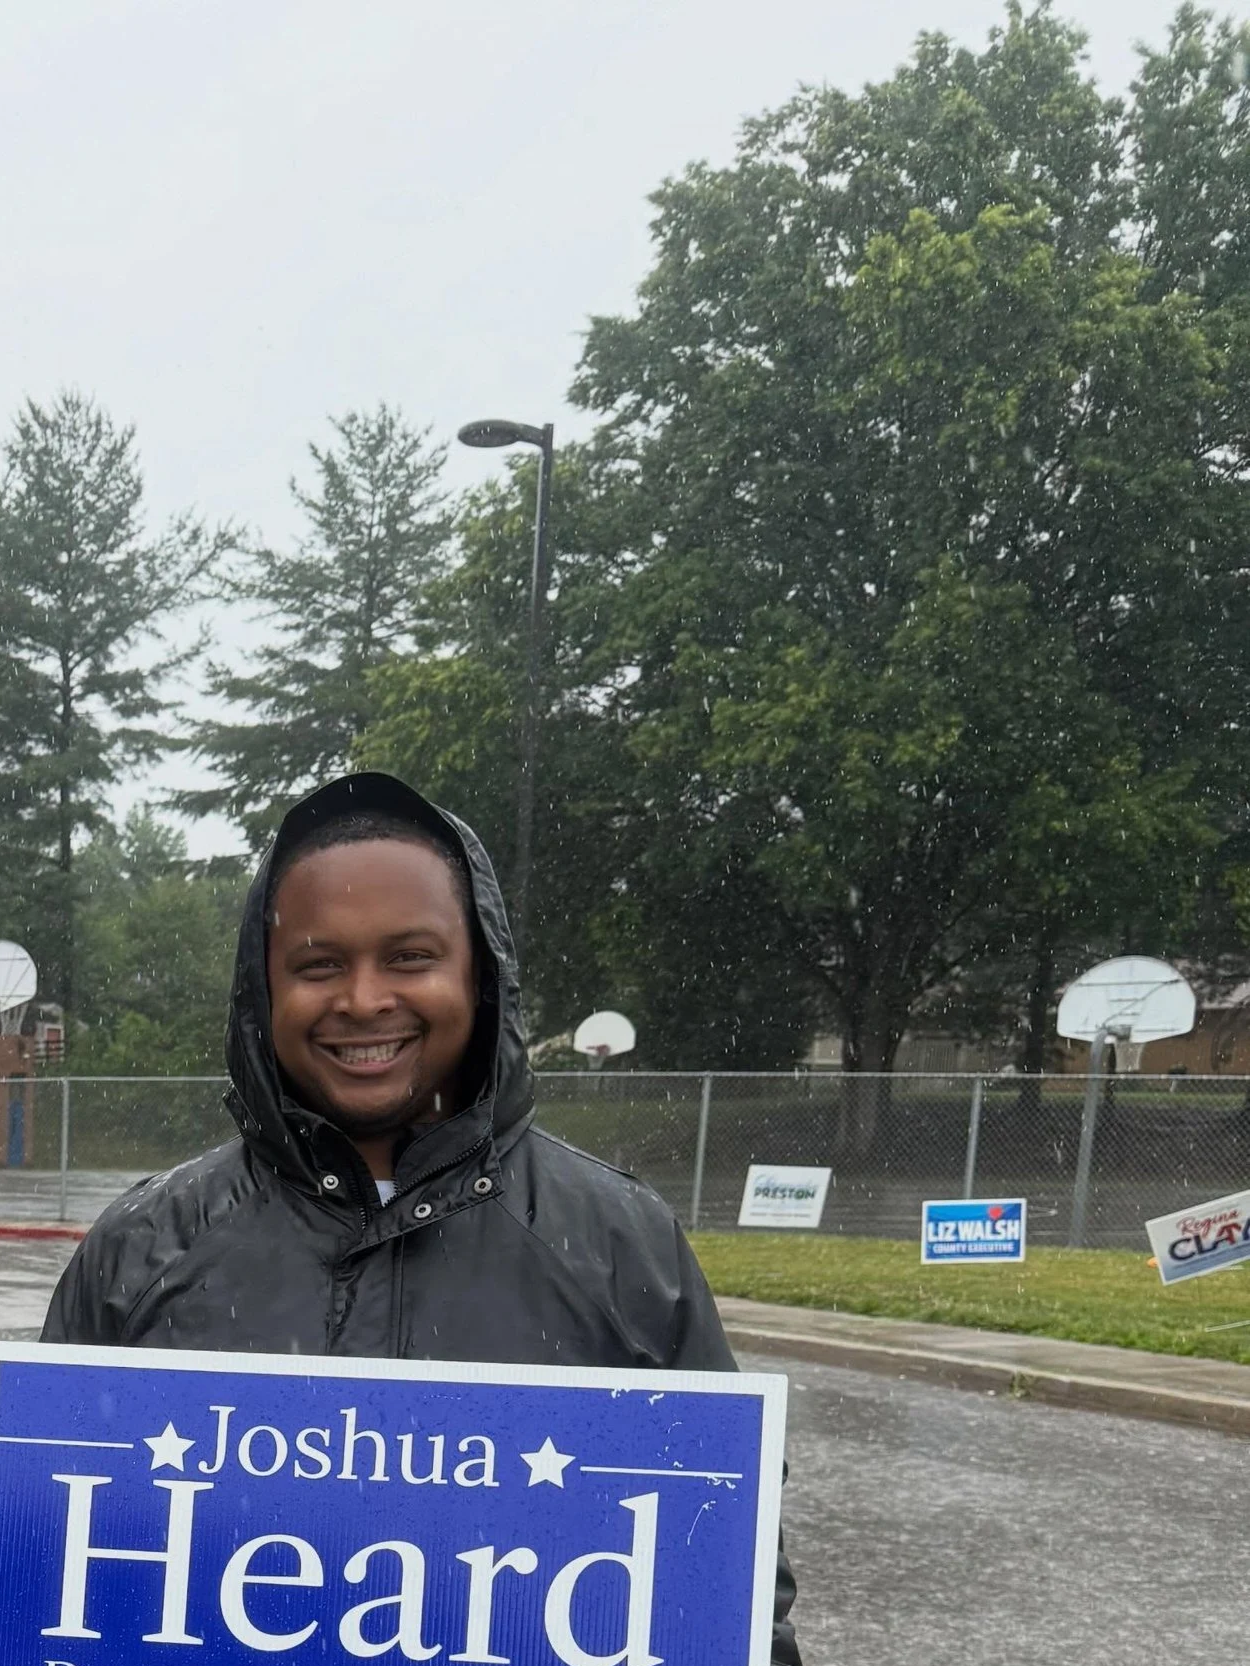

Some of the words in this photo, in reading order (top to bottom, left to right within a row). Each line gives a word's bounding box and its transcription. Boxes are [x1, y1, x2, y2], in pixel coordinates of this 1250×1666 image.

[753, 1186, 817, 1200] PRESTON
[928, 1221, 957, 1243] LIZ
[957, 1219, 1021, 1242] WALSH
[1176, 1208, 1240, 1239] Regina
[933, 1243, 967, 1255] COUNTY
[968, 1241, 1015, 1254] EXECUTIVE
[197, 1405, 500, 1488] Joshua
